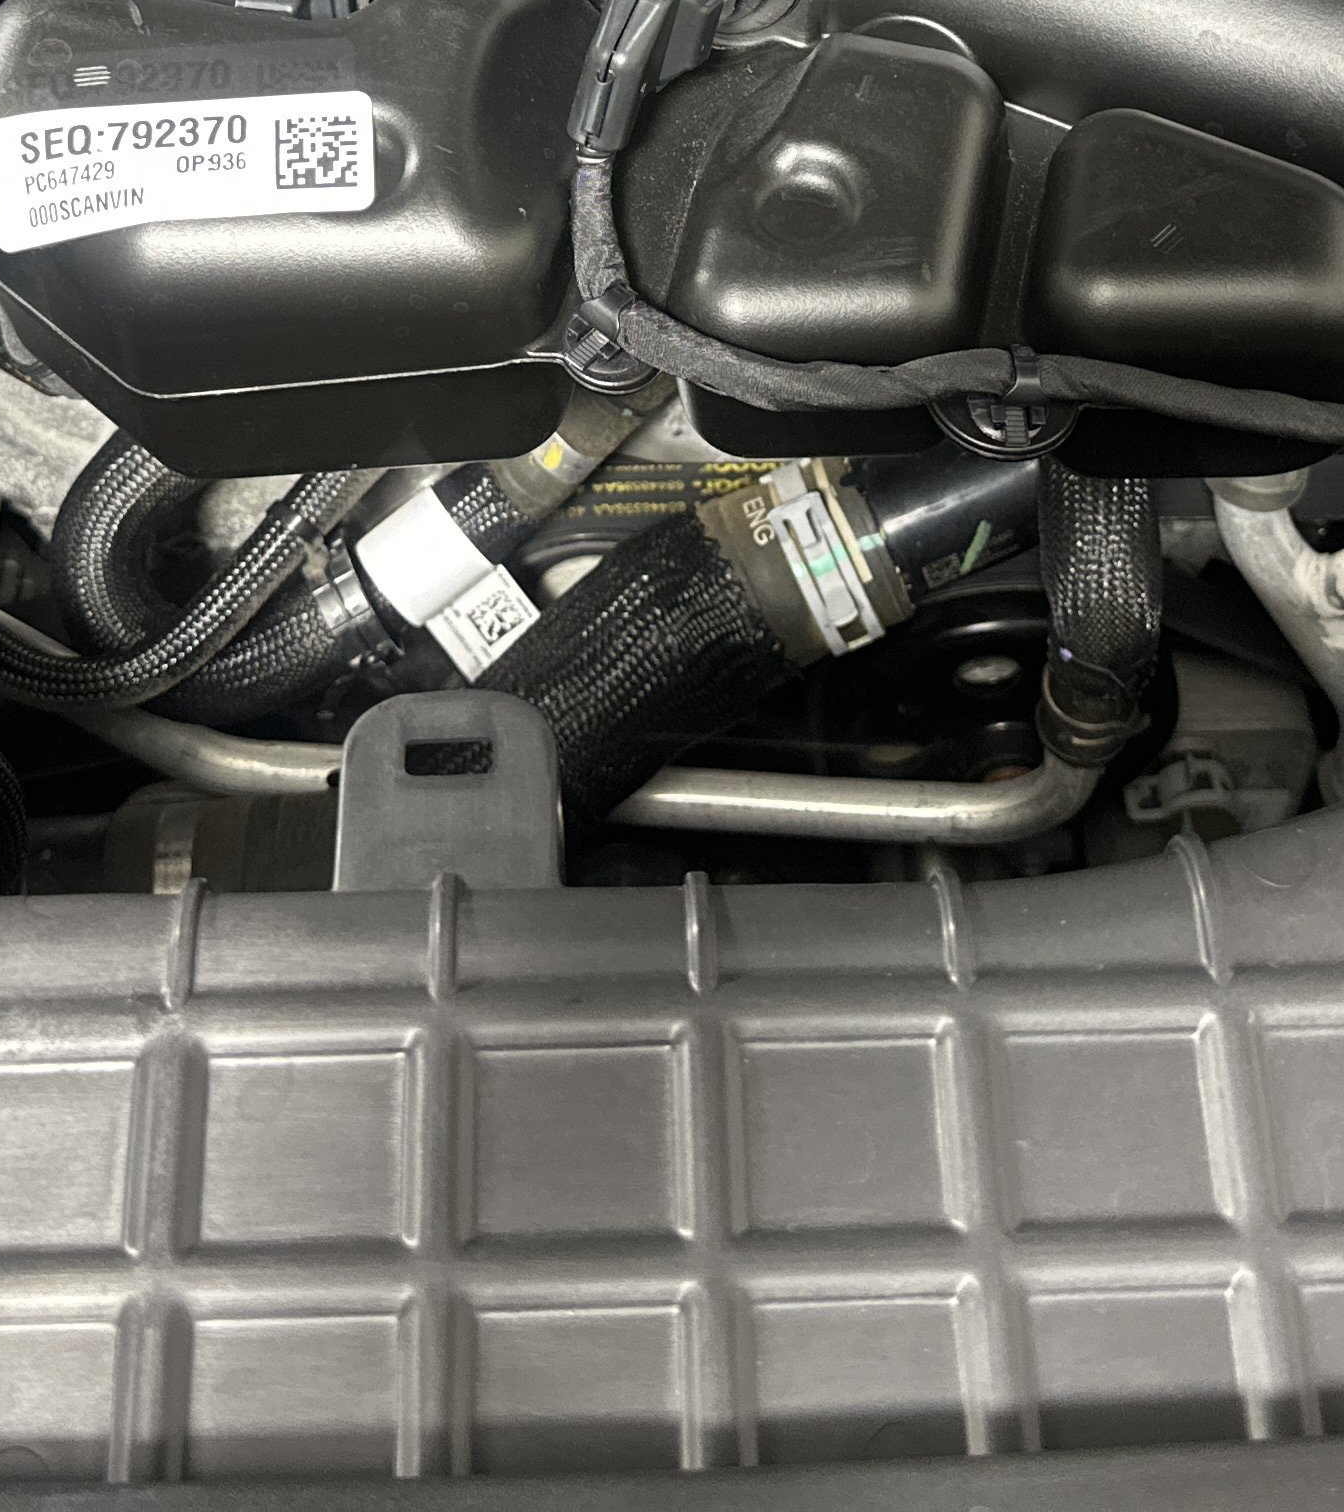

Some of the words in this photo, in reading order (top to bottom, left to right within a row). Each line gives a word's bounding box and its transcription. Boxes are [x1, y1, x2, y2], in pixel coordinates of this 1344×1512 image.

[19, 114, 248, 165] SEQ:792370
[24, 160, 116, 196] PC647429
[28, 187, 145, 228] 000SCANVIN
[742, 495, 775, 547] ENG
